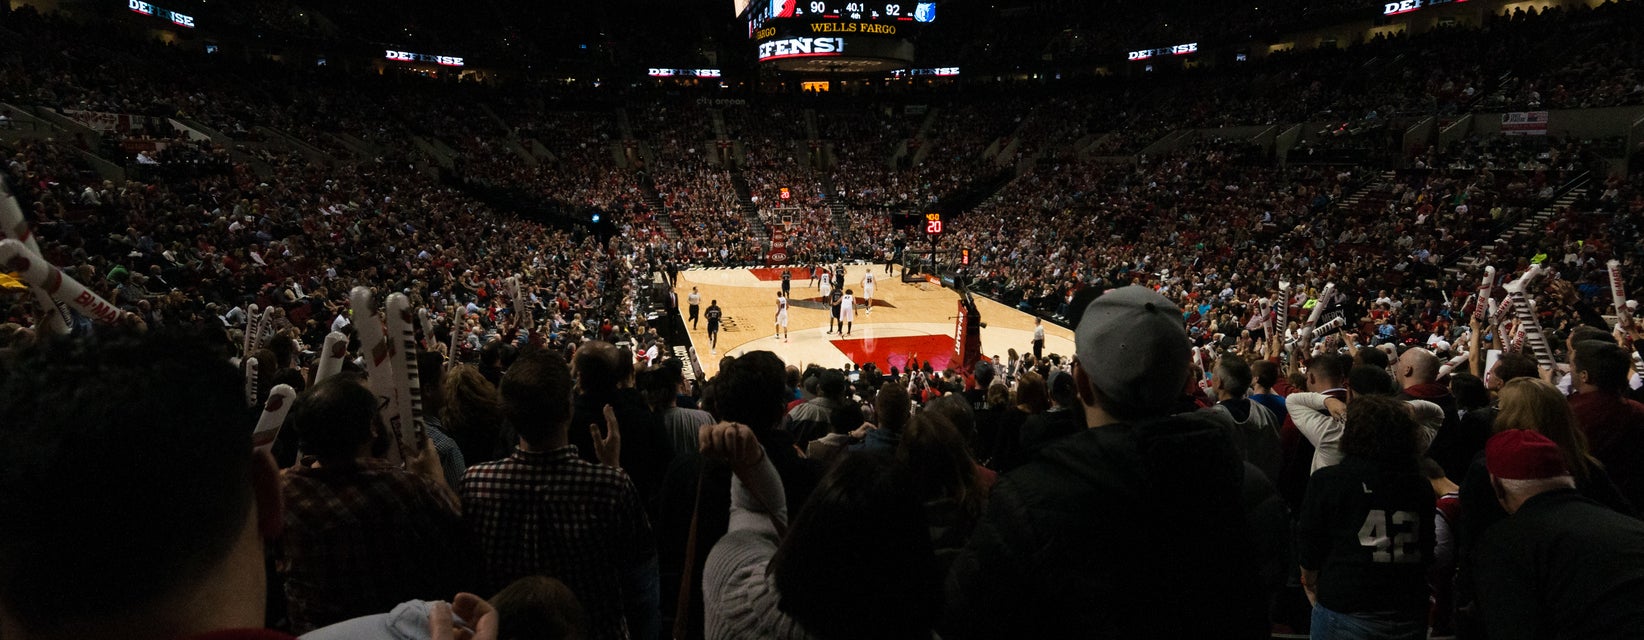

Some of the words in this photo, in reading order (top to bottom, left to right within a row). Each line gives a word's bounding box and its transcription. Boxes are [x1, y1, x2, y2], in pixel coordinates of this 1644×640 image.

[811, 1, 825, 13] 90
[846, 3, 864, 12] 40.1
[886, 4, 900, 16] 92
[128, 0, 195, 27] DEFENSE
[811, 23, 857, 33] WELLS
[860, 23, 896, 35] FARGO
[1128, 42, 1198, 60] DEFENSE
[385, 50, 465, 66] DEFENSE
[648, 68, 721, 77] DEFENSE
[927, 220, 941, 233] 20
[1357, 508, 1423, 564] 42
